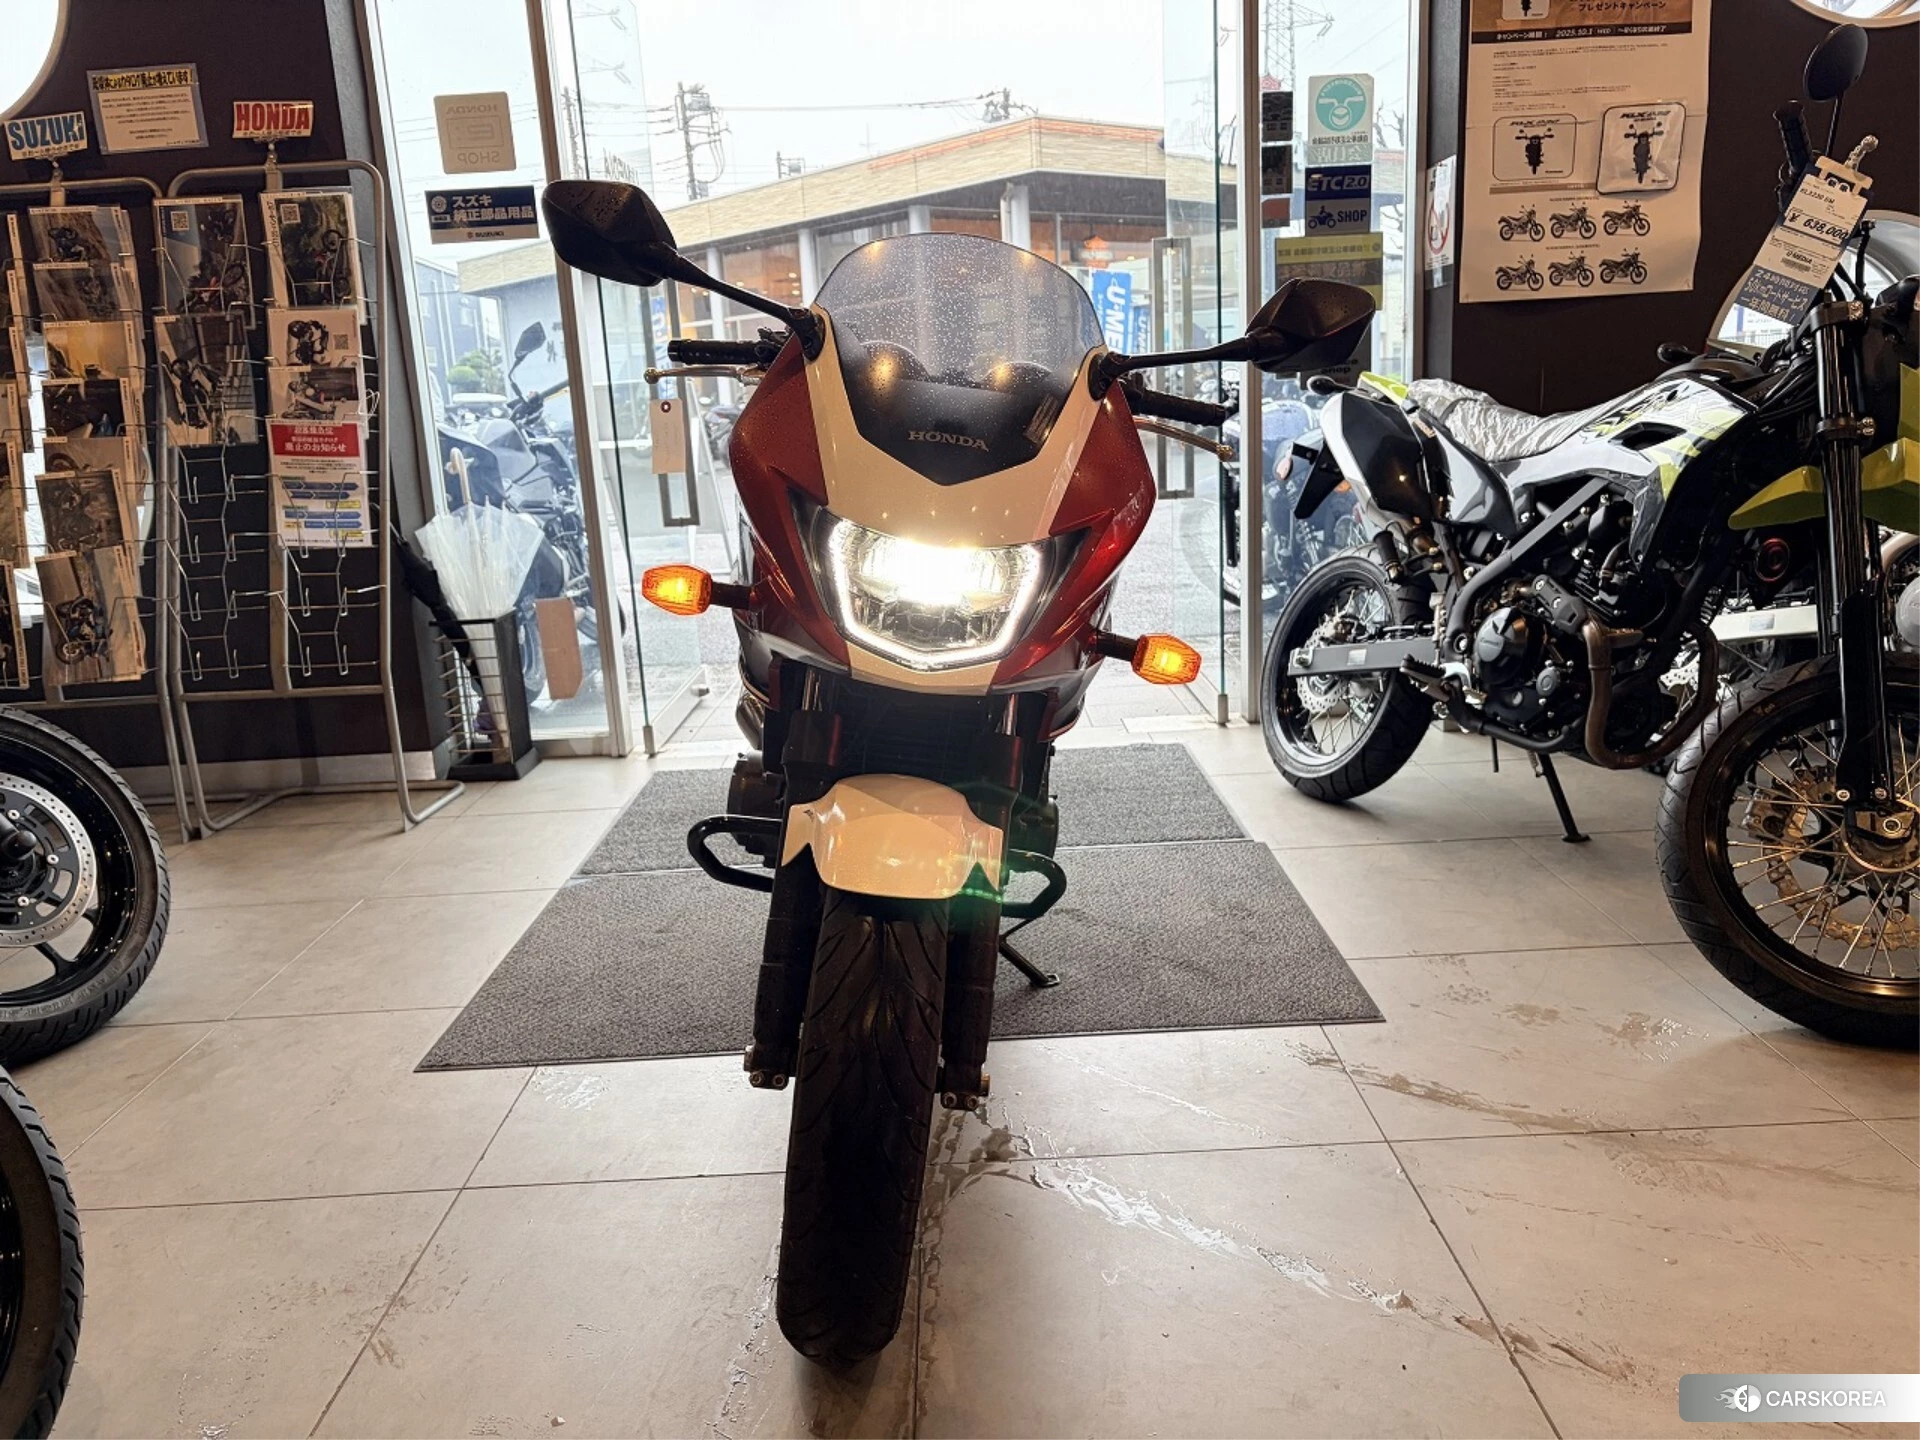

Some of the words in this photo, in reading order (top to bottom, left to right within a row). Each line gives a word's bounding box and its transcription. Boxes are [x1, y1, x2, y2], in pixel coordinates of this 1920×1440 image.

[1579, 1, 1667, 11] プレゼントキャンペーン
[236, 103, 310, 130] HONDA
[8, 114, 85, 150] SUZUKI
[1308, 174, 1344, 191] ETC
[1346, 176, 1369, 190] 2.0
[452, 194, 492, 208] スズキ
[453, 206, 535, 224] 純正部品用品
[1337, 209, 1368, 222] SHOP
[1803, 218, 1849, 239] 638,000
[908, 431, 990, 452] HONDA
